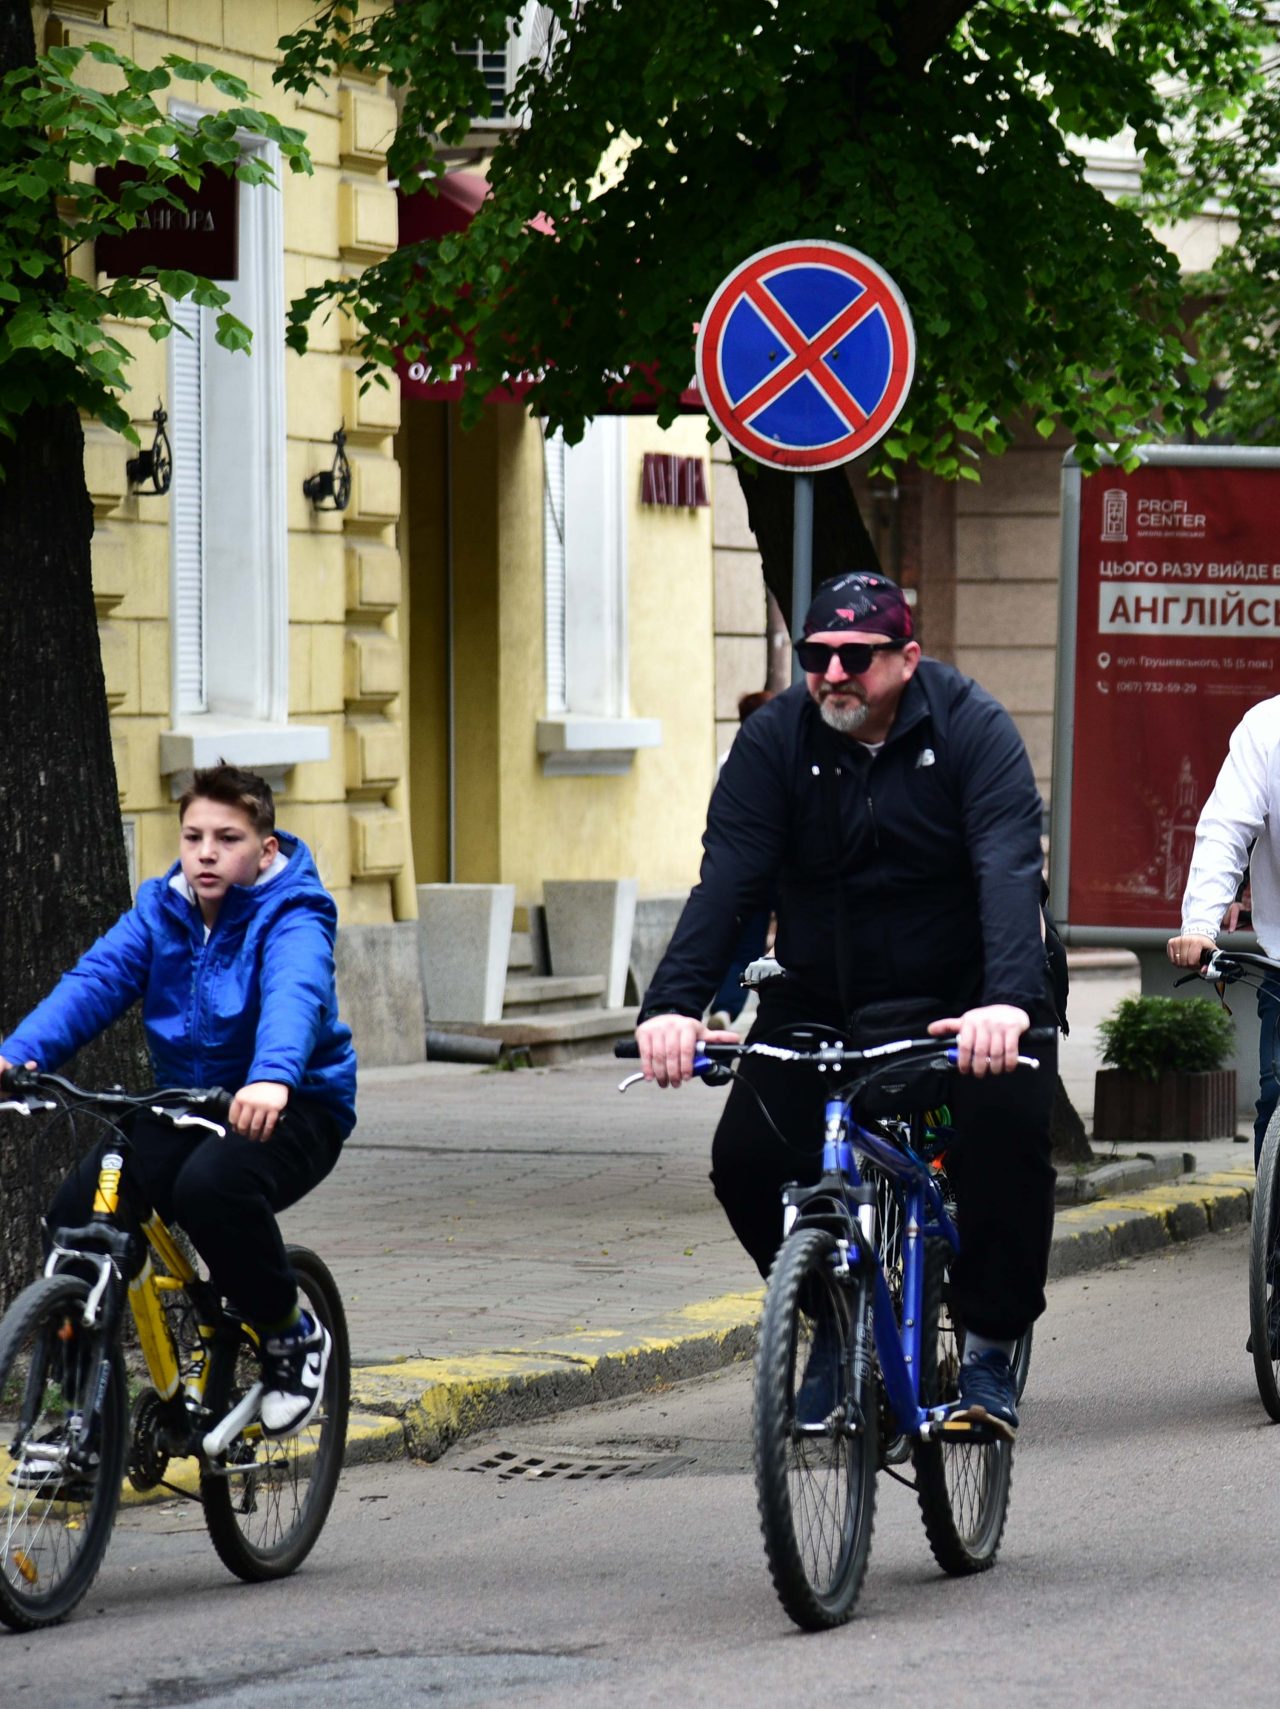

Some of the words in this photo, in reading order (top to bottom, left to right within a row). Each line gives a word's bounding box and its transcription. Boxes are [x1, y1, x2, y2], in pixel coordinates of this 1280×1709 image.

[1137, 499, 1188, 513] PROFI
[1137, 513, 1206, 527] CENTER
[1100, 561, 1158, 576] ЦЬОГО
[1162, 562, 1204, 577] РАЗУ
[1208, 563, 1268, 580] ВИЙДЕ
